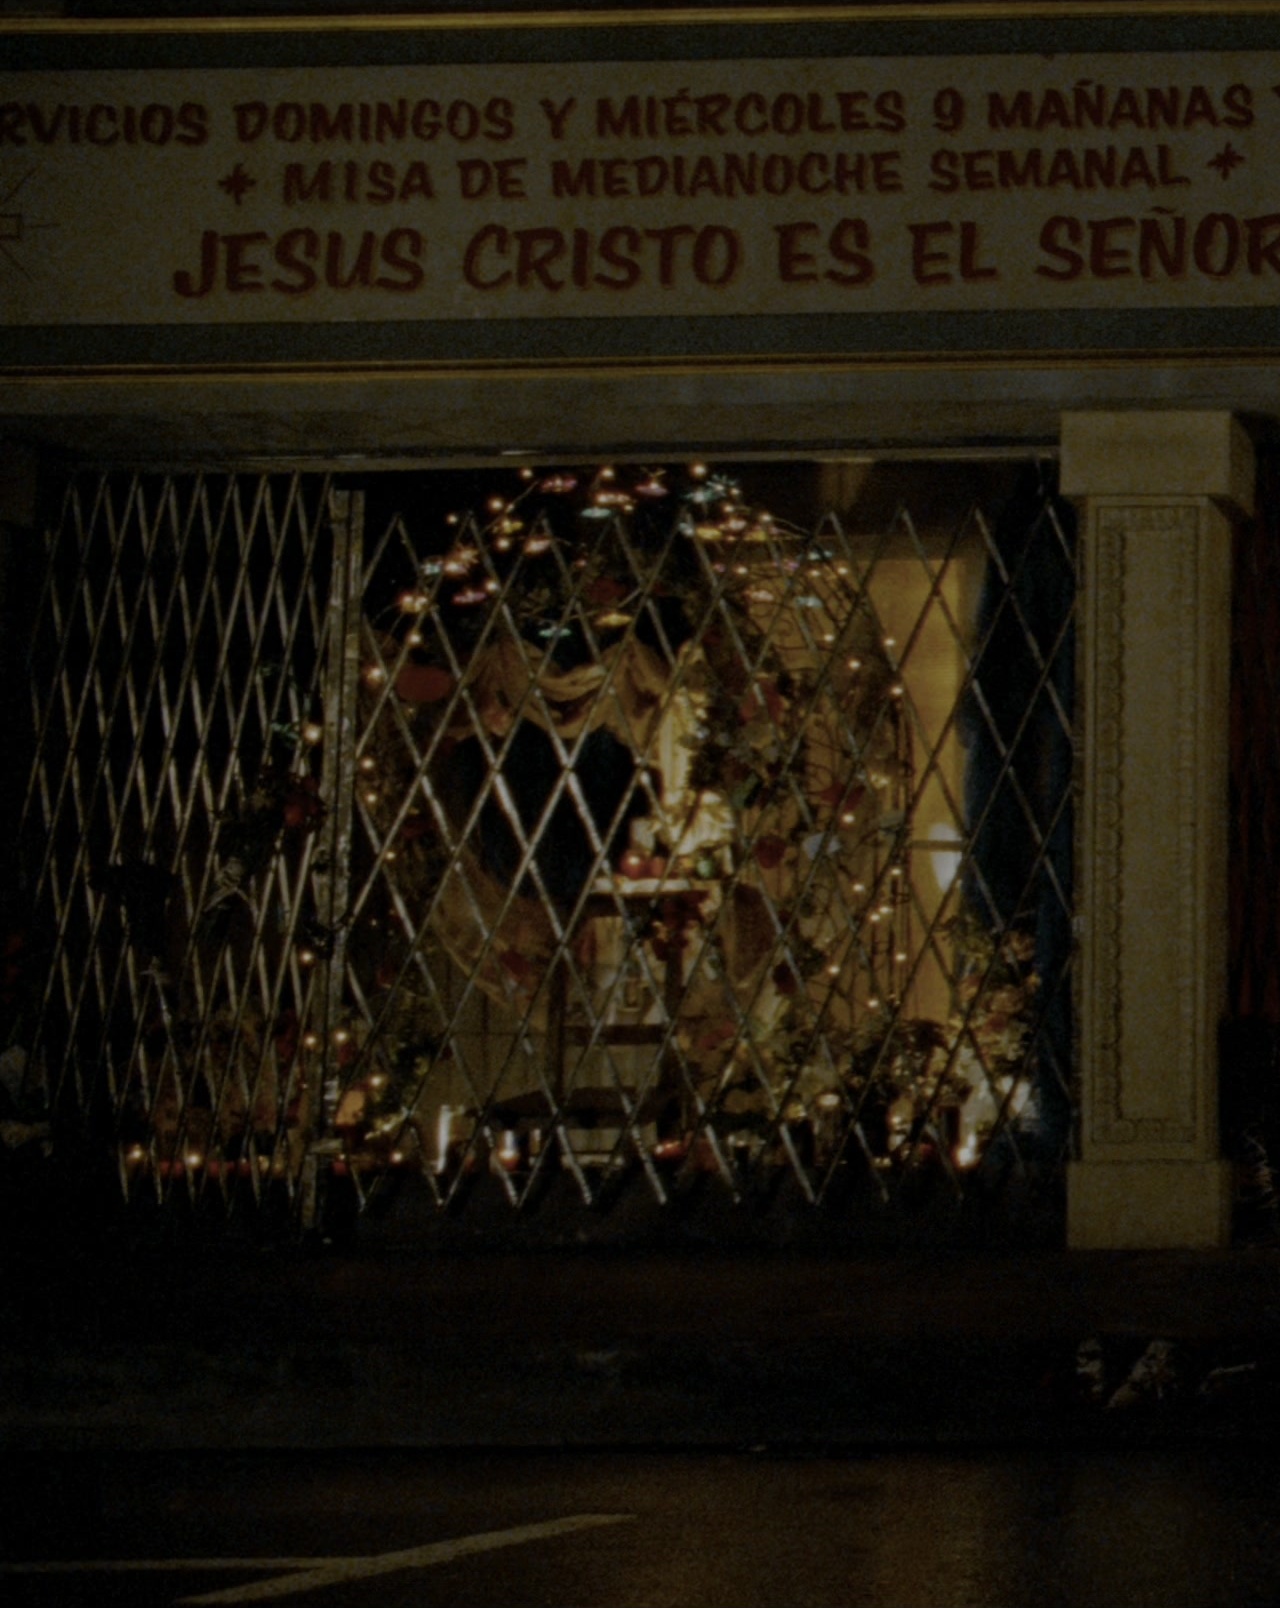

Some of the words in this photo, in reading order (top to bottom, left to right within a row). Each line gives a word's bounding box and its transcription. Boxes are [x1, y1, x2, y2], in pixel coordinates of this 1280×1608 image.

[235, 98, 514, 143] DOMINGOS
[542, 98, 576, 141] Y
[596, 88, 906, 137] MIÉRCOLES
[933, 88, 965, 134] 9
[988, 80, 1254, 129] MAÑANAS
[283, 161, 434, 204] MISA
[458, 159, 524, 200] DE
[552, 151, 900, 198] MEDIANOCHE
[931, 145, 1184, 193] SEMANAL
[174, 228, 423, 298] JESUS
[464, 225, 740, 292] CRISTO
[779, 219, 874, 286] ES
[910, 222, 997, 285] EL
